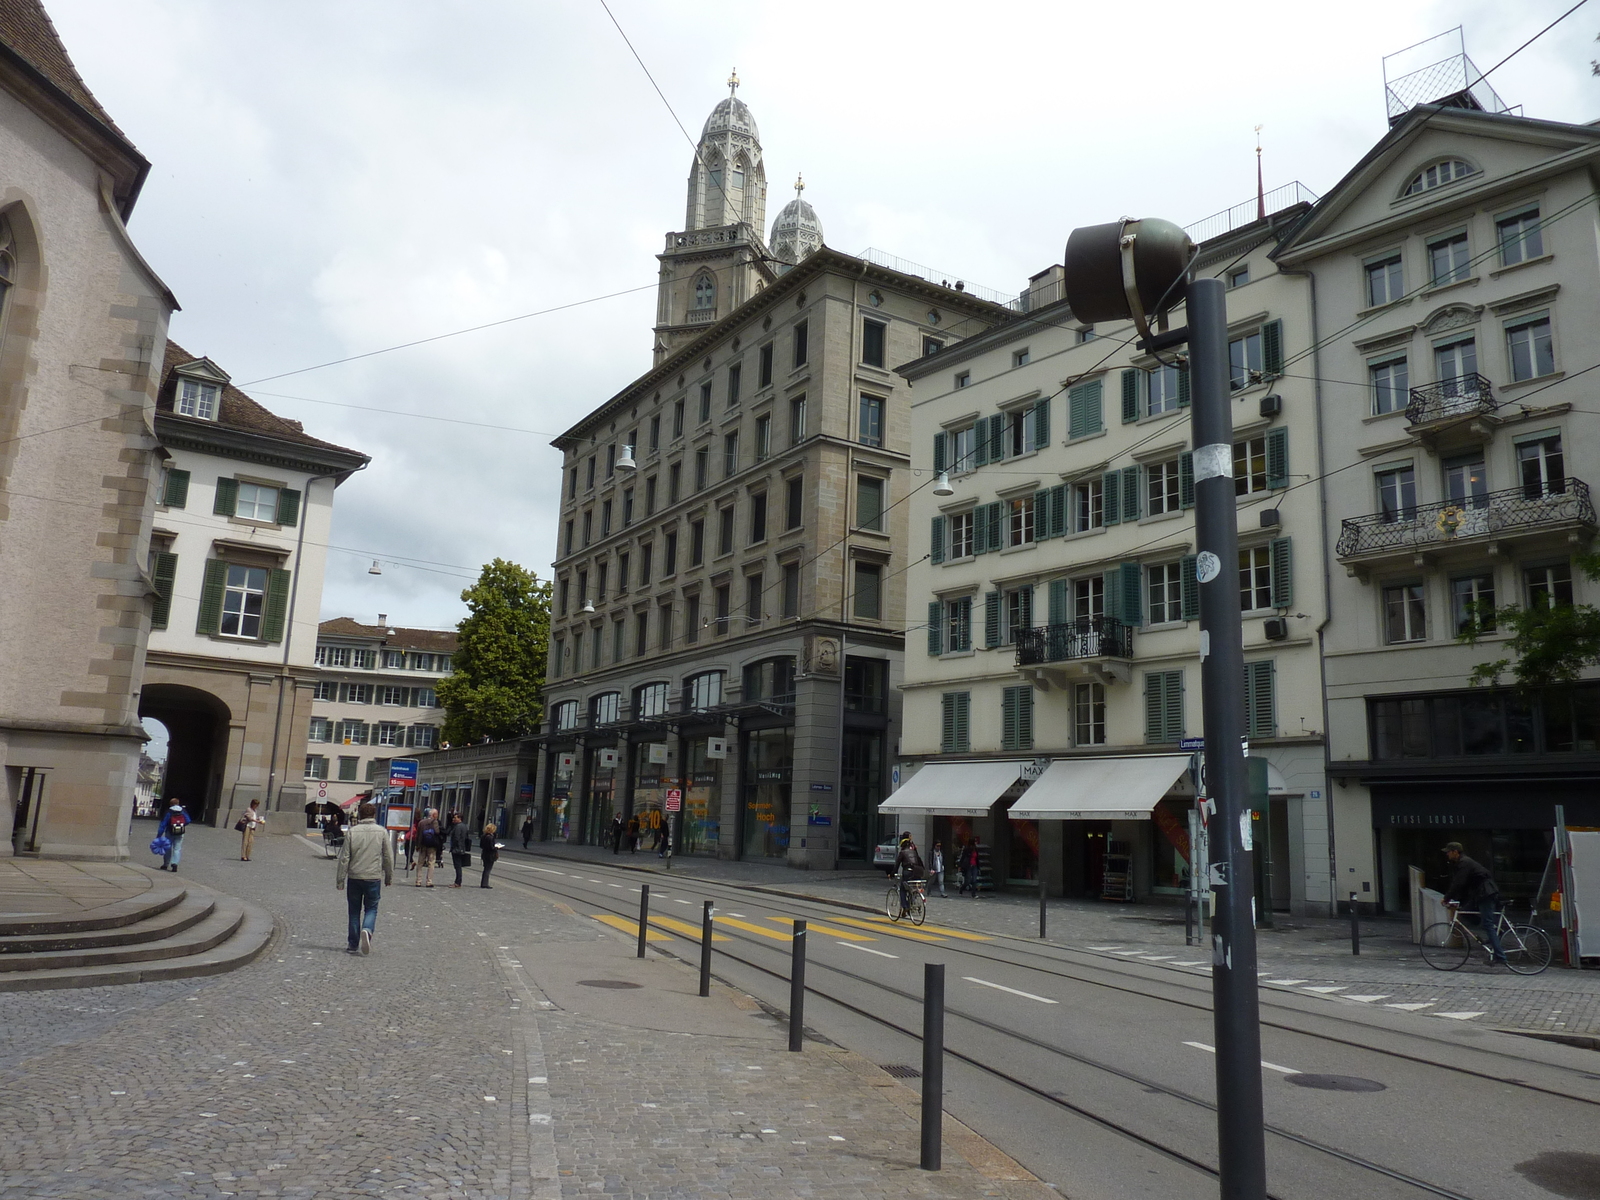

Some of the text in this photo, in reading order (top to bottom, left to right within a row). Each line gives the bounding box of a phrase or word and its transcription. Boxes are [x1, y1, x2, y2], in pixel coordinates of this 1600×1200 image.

[1180, 739, 1204, 749] Limmatqua
[1024, 766, 1044, 776] MAX
[756, 812, 775, 821] Hoch
[1176, 835, 1190, 858] SAL
